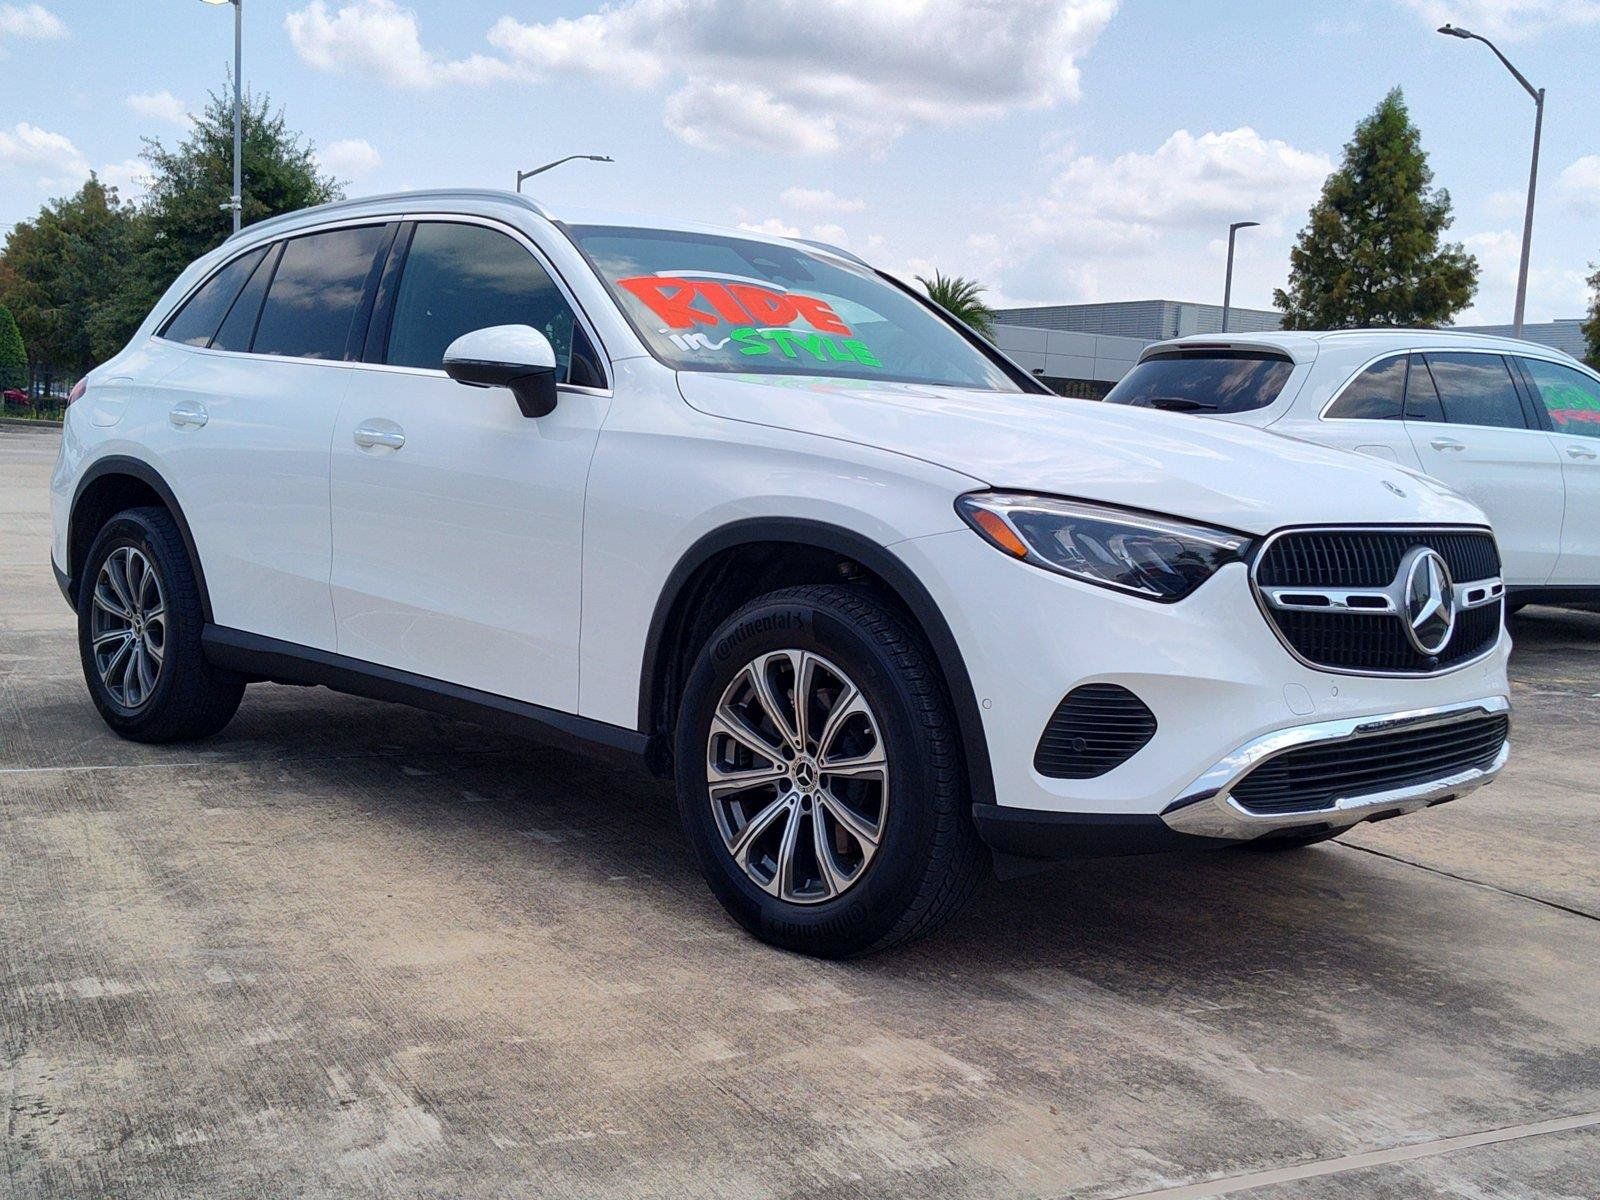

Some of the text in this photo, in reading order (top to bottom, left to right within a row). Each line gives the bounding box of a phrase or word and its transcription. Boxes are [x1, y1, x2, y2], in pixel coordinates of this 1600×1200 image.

[617, 276, 853, 336] RIDE
[658, 328, 883, 368] in STYLE
[715, 612, 791, 660] Continental
